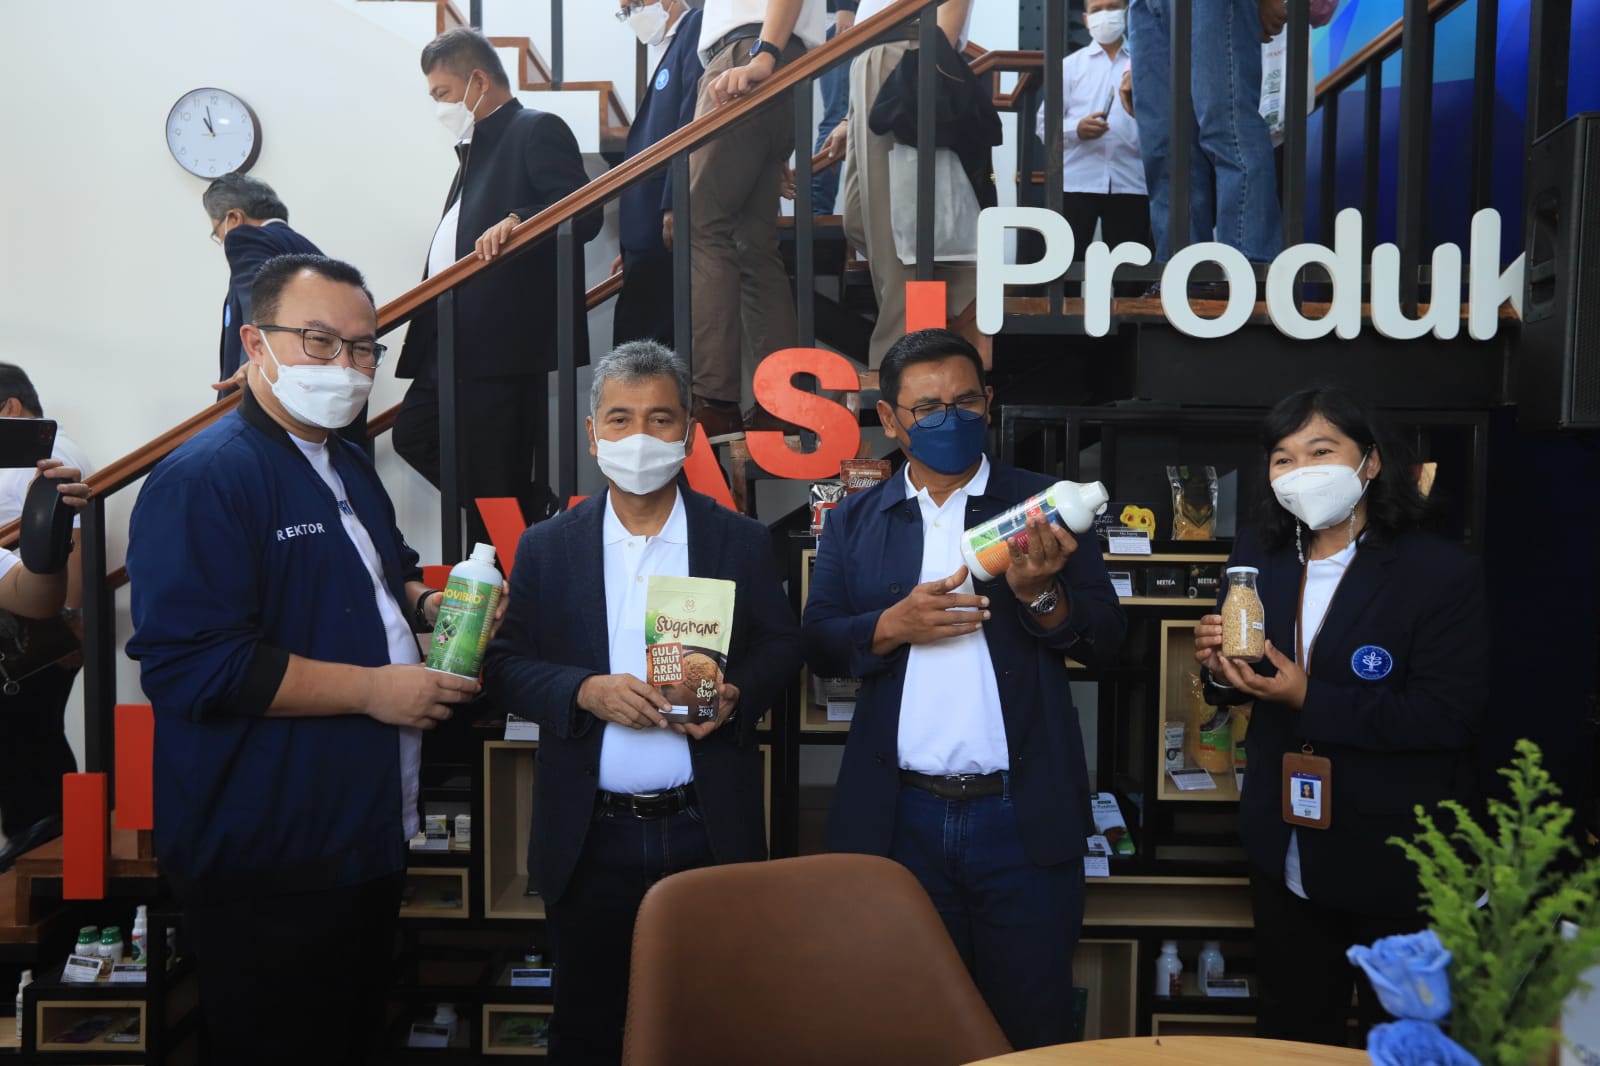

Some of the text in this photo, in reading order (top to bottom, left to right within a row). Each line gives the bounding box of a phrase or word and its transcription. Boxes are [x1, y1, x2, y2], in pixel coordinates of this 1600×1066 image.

[209, 95, 219, 105] 12
[179, 111, 192, 122] 10
[976, 206, 1525, 341] Produk
[276, 523, 325, 541] REKTOR
[652, 645, 680, 657] GULA
[653, 655, 680, 665] SEMUT
[653, 663, 681, 675] AREN
[653, 673, 682, 683] CIKADU
